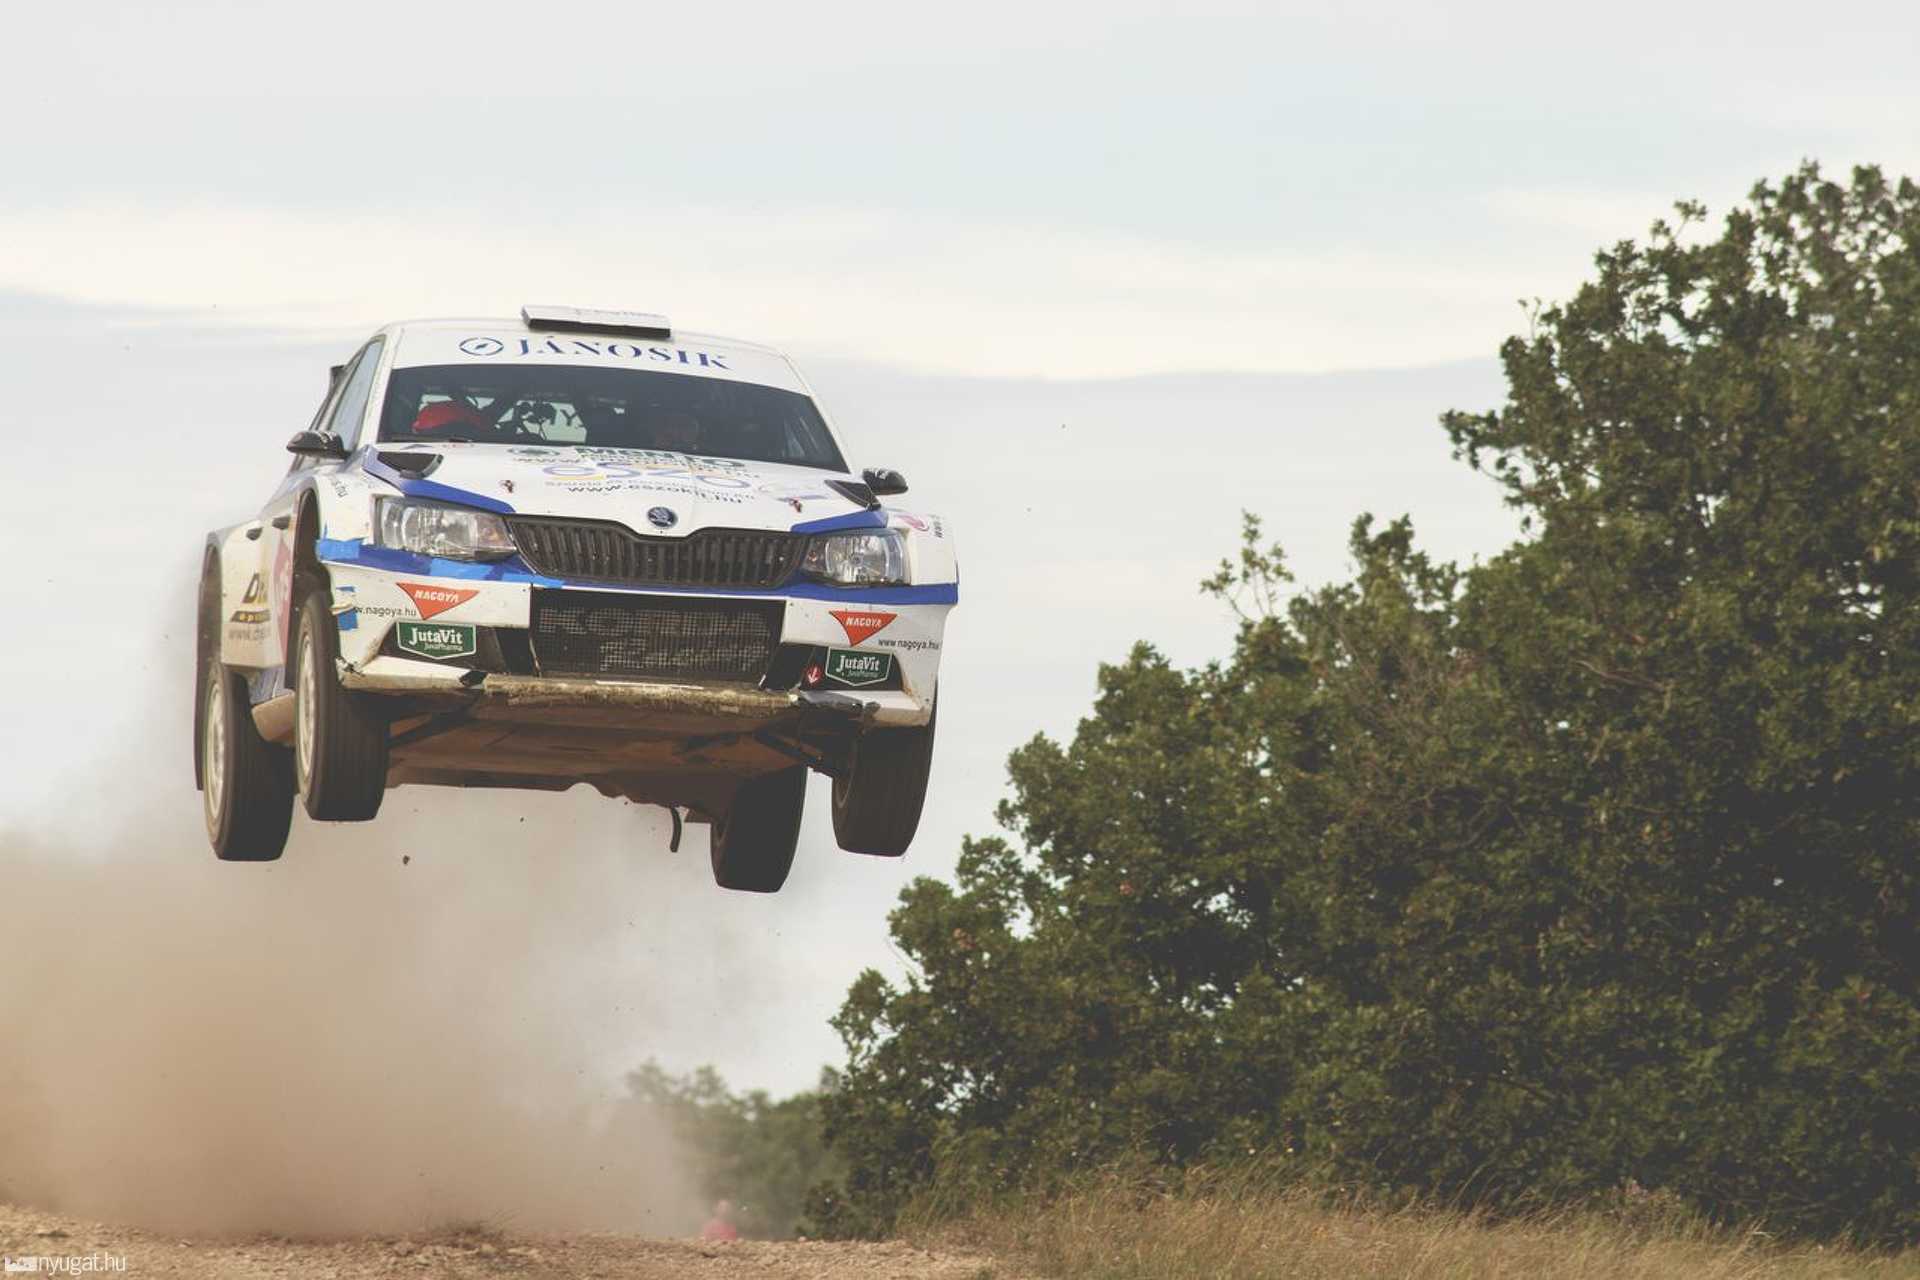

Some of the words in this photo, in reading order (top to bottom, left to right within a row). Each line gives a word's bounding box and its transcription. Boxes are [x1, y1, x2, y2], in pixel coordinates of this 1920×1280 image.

[517, 335, 731, 370] JÁNOSIK
[414, 589, 459, 603] NAGOYA
[846, 617, 882, 628] NAGOYA
[409, 627, 463, 646] JutaVit
[878, 639, 939, 651] www.nagoya.hu
[836, 655, 880, 673] JutaVit
